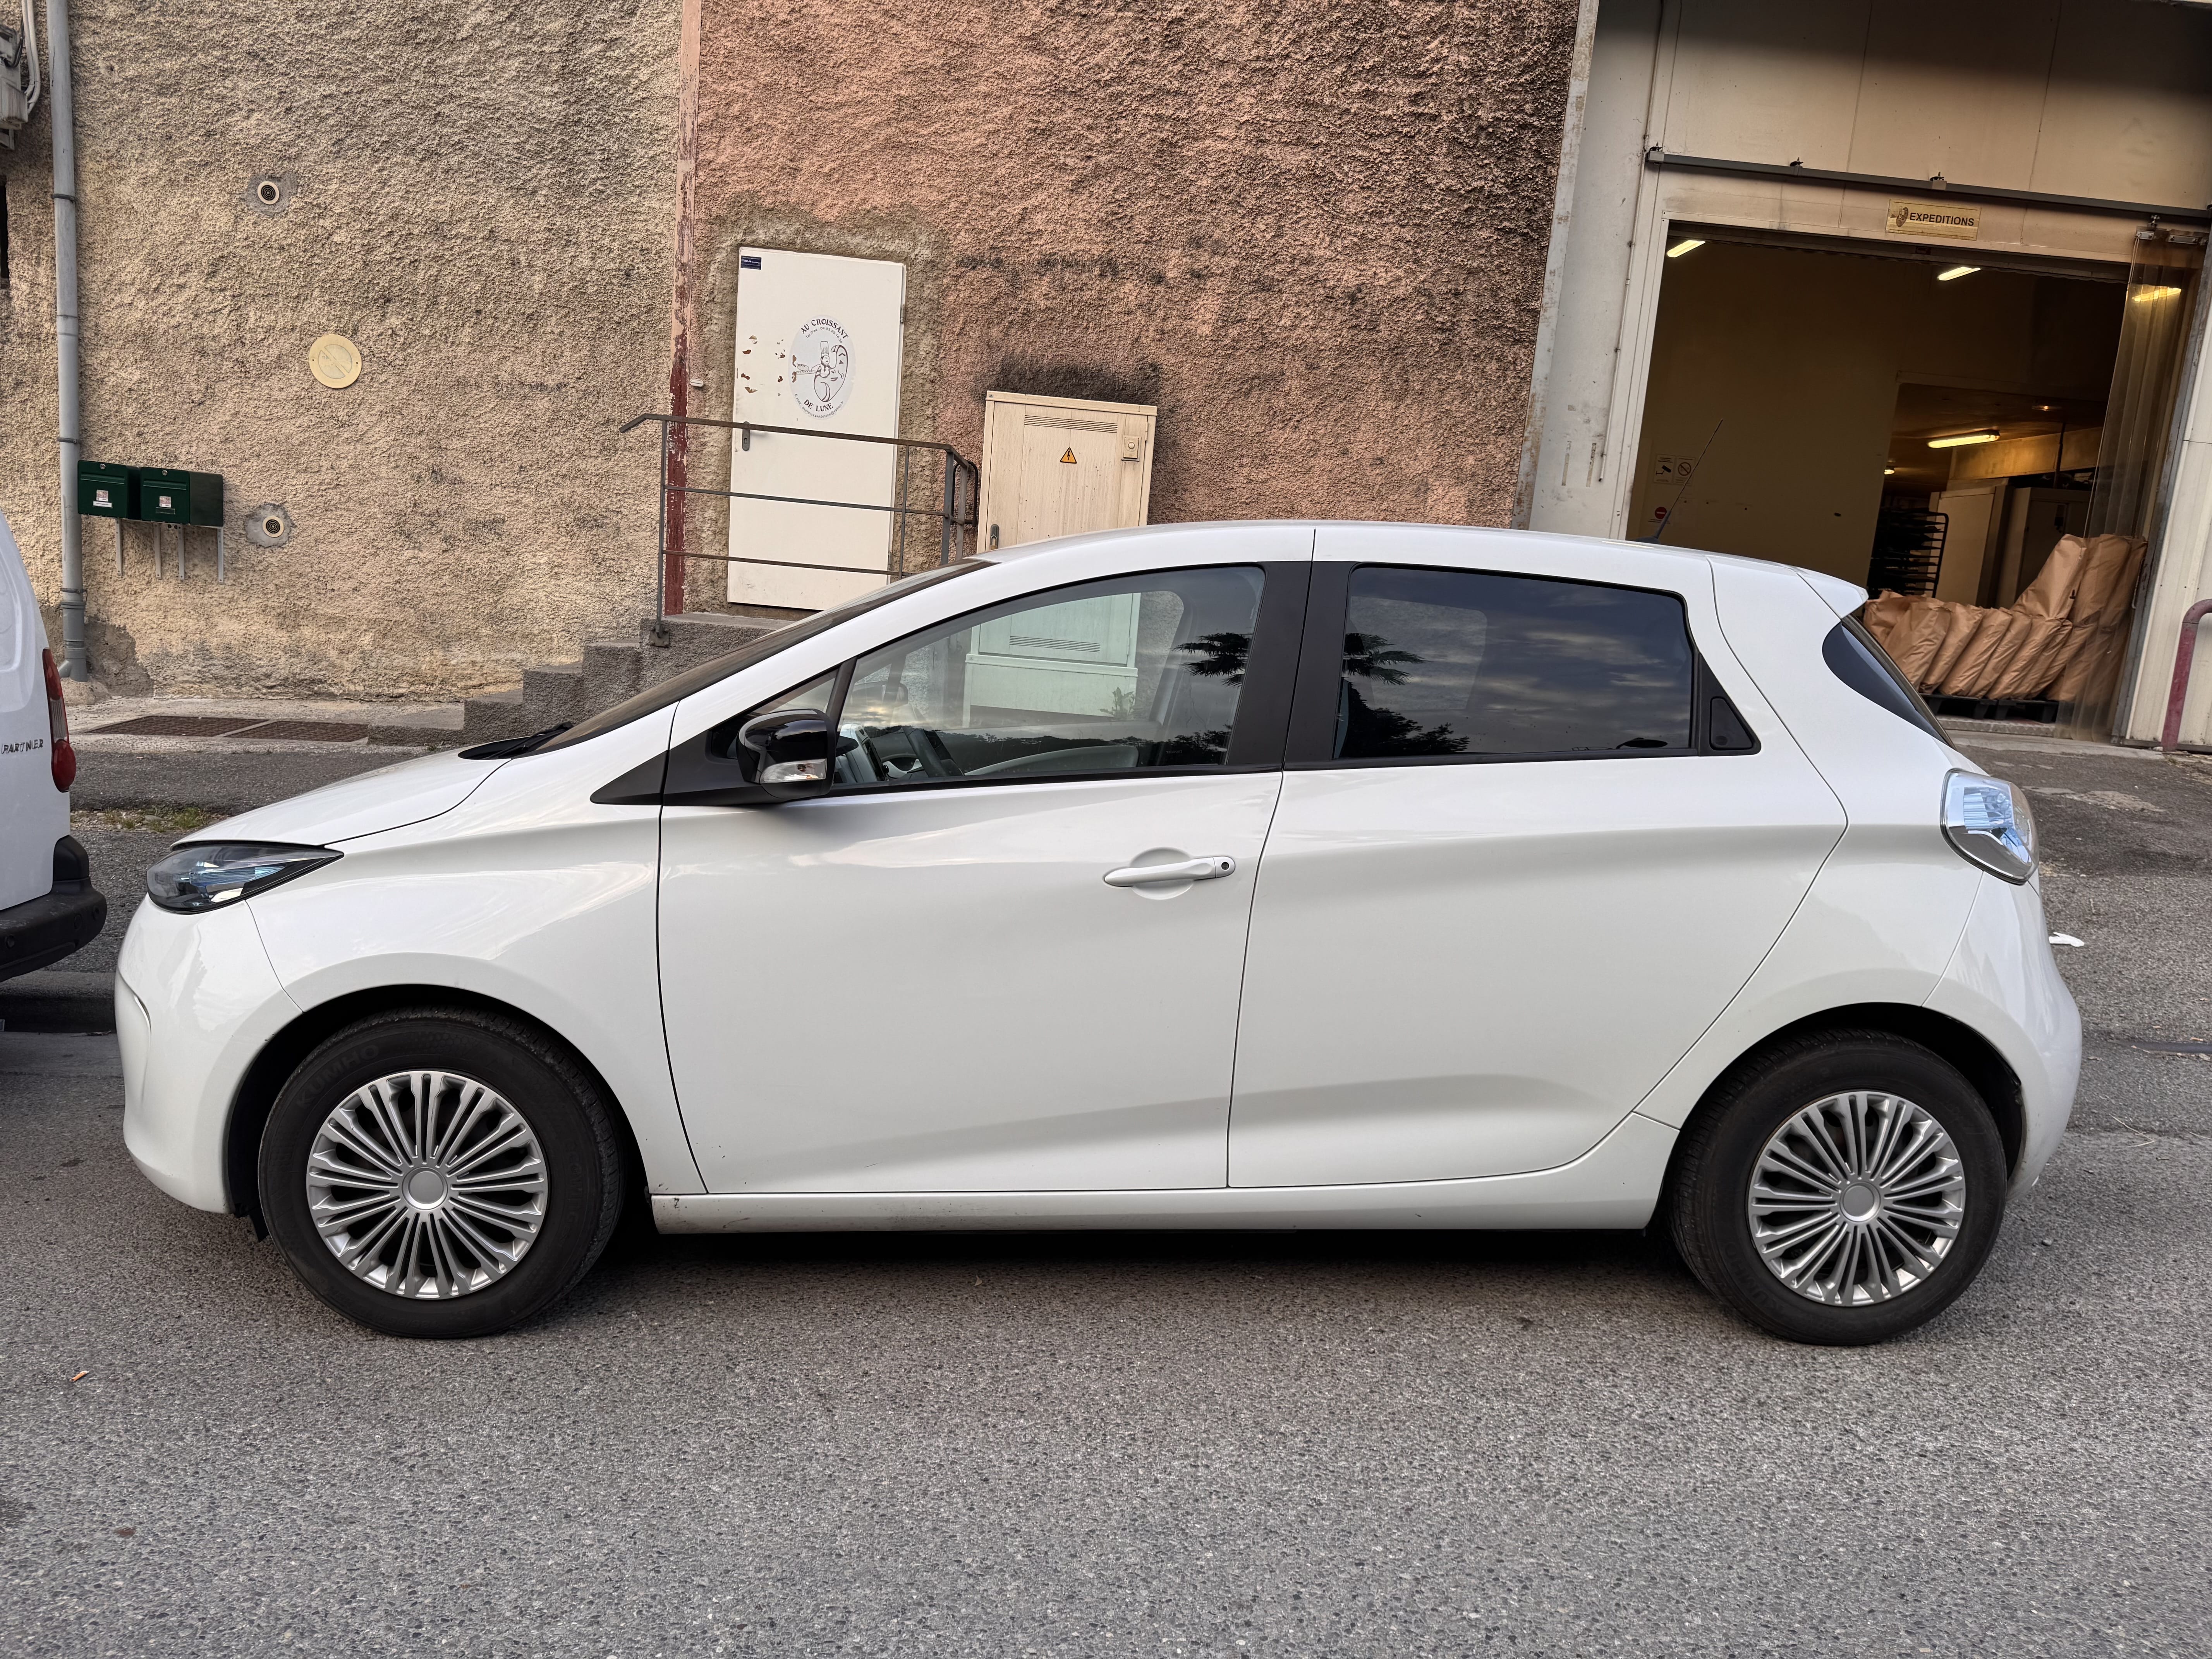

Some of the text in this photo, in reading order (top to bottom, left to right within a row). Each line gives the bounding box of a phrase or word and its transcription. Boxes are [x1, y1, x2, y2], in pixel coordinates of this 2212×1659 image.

[1910, 213, 1975, 226] EXPEDITIONS
[801, 318, 849, 339] AU CROISSANT
[804, 399, 833, 412] DE LUNE
[2, 738, 44, 754] PARTNER
[296, 1044, 379, 1109] KUMHO
[1724, 1242, 1785, 1313] KUMHO
